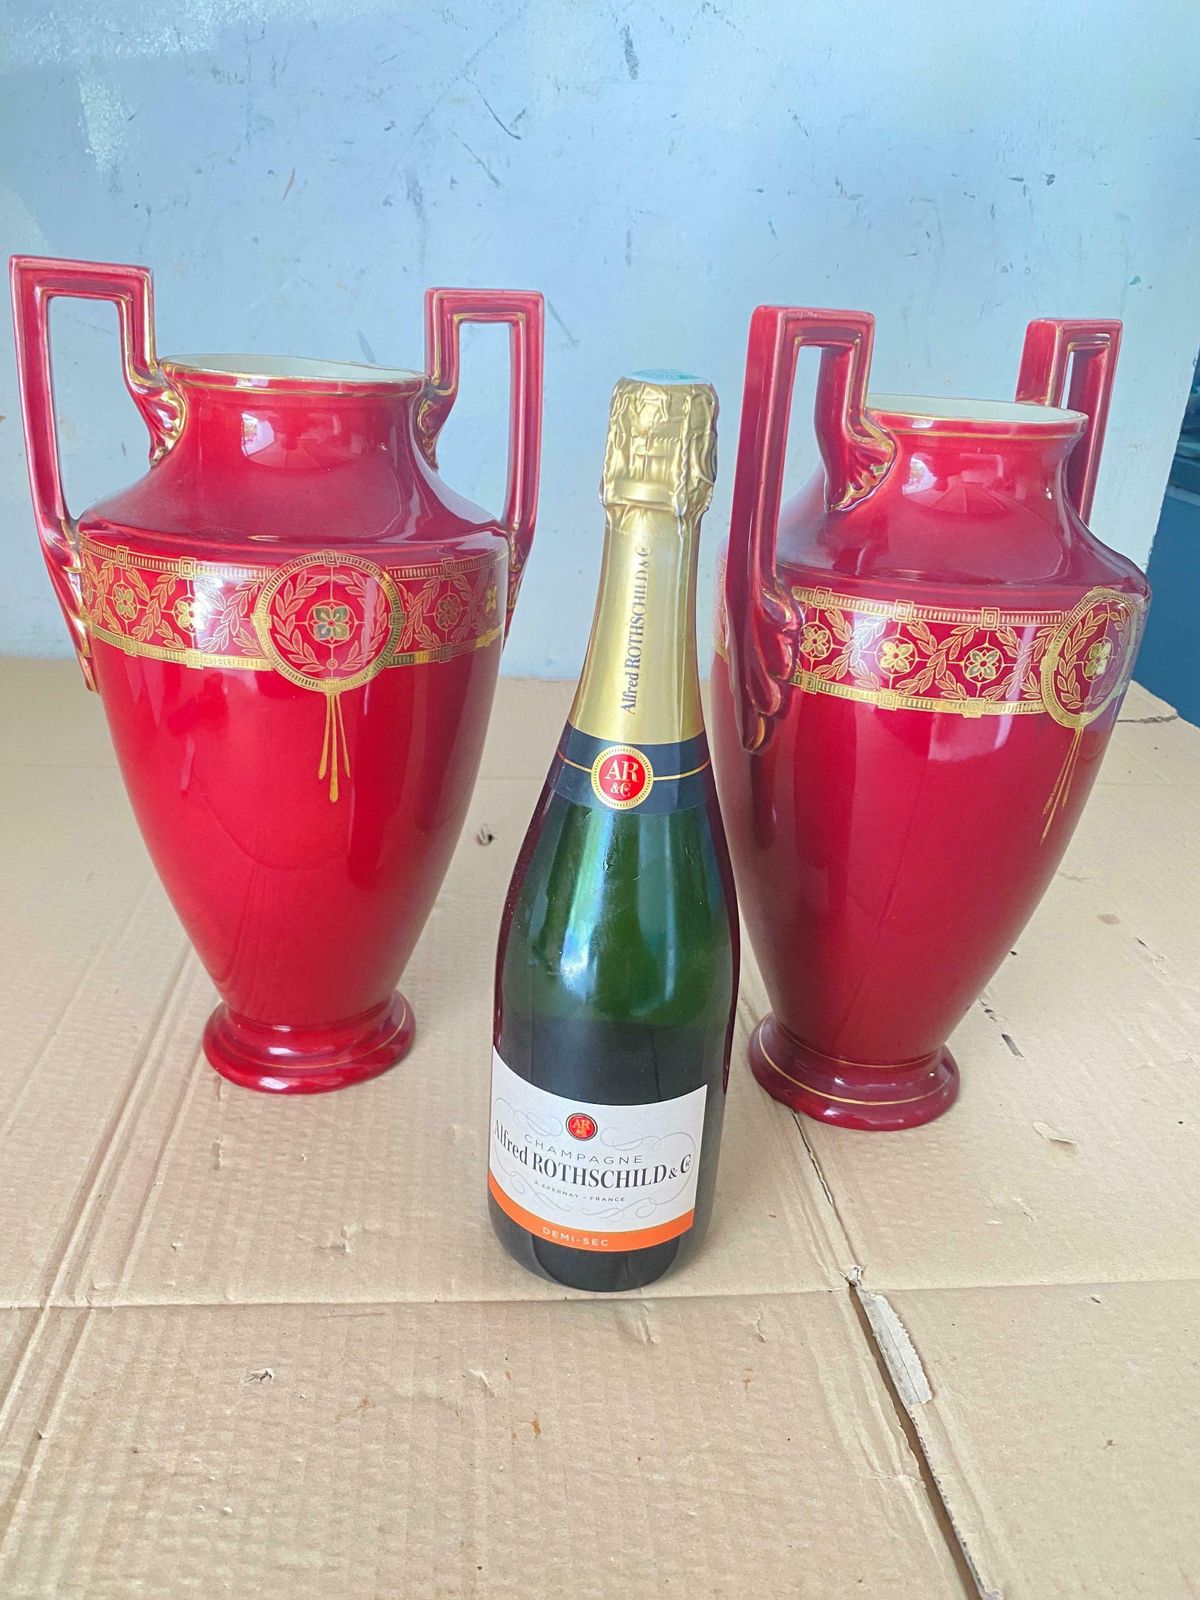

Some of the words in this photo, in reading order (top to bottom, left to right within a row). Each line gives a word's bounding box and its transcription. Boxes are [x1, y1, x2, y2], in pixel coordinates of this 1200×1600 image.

[624, 569, 648, 670] ROTHSCHILD
[620, 672, 639, 715] Alfred
[603, 759, 640, 783] AR
[493, 1119, 528, 1166] Alfred
[532, 1151, 667, 1189] ROTHSCHILD
[524, 1133, 643, 1165] CHAMPAGNE
[541, 1226, 609, 1247] DEMI-SEC
